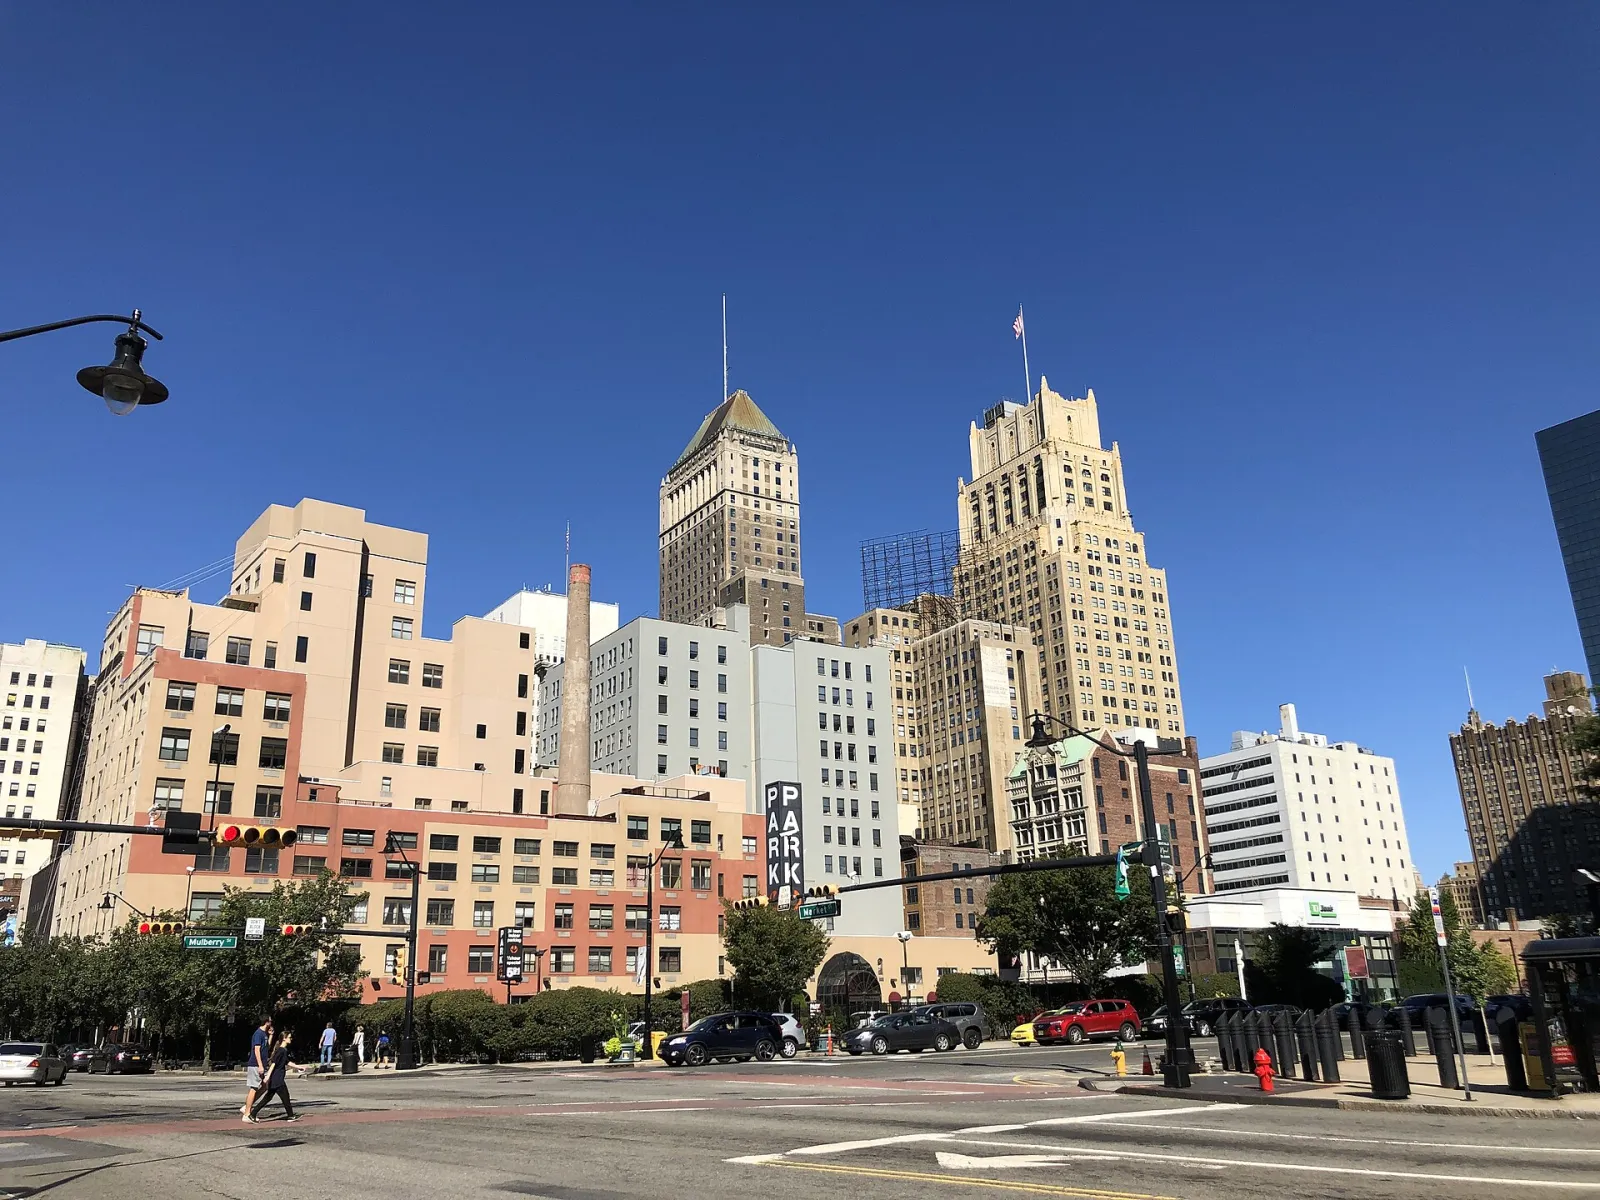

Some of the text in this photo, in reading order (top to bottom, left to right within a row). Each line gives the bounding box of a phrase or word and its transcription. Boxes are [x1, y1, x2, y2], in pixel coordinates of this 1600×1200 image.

[767, 786, 779, 885] PARK
[782, 785, 801, 884] PARK
[803, 906, 828, 916] Market
[188, 938, 225, 947] Mulberry
